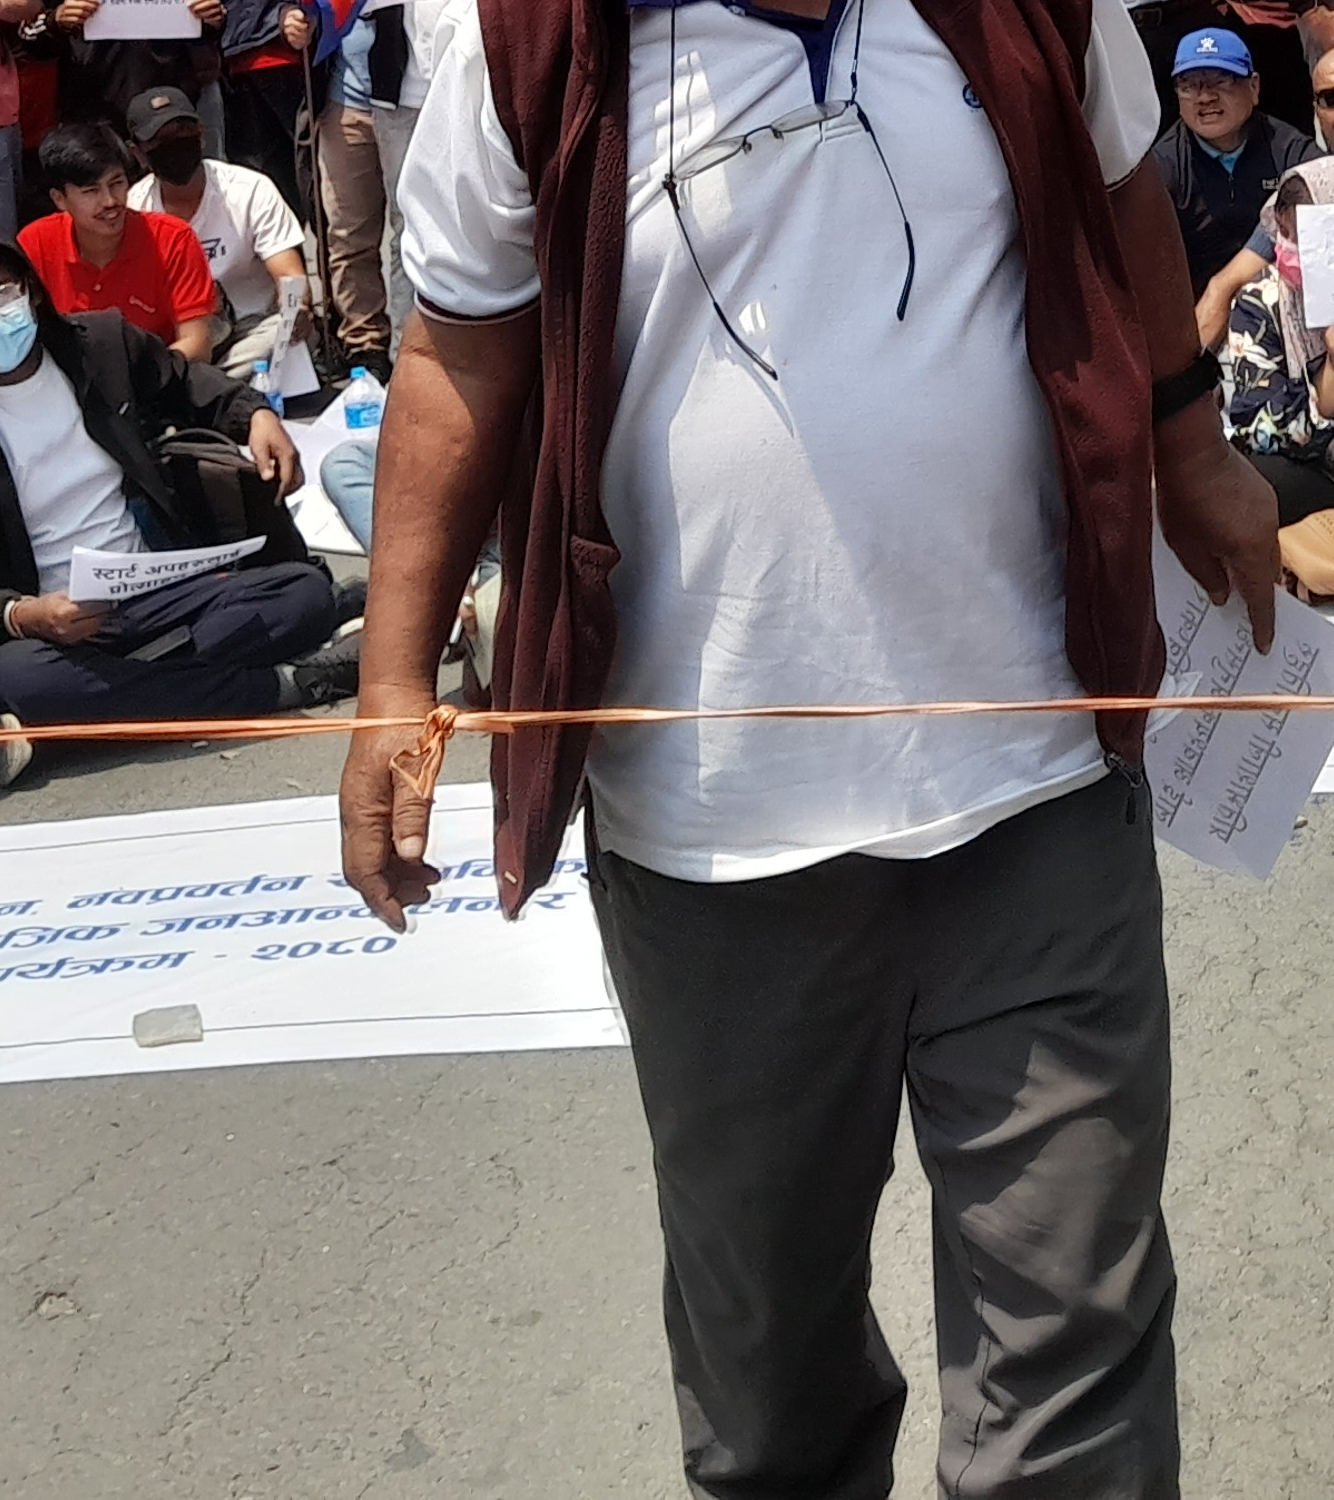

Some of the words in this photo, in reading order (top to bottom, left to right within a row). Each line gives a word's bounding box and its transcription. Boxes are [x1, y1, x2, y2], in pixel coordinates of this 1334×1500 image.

[92, 563, 140, 581] स्टार्ट
[65, 873, 313, 914] नवप्रवर्तन
[251, 936, 399, 962] २०८०
